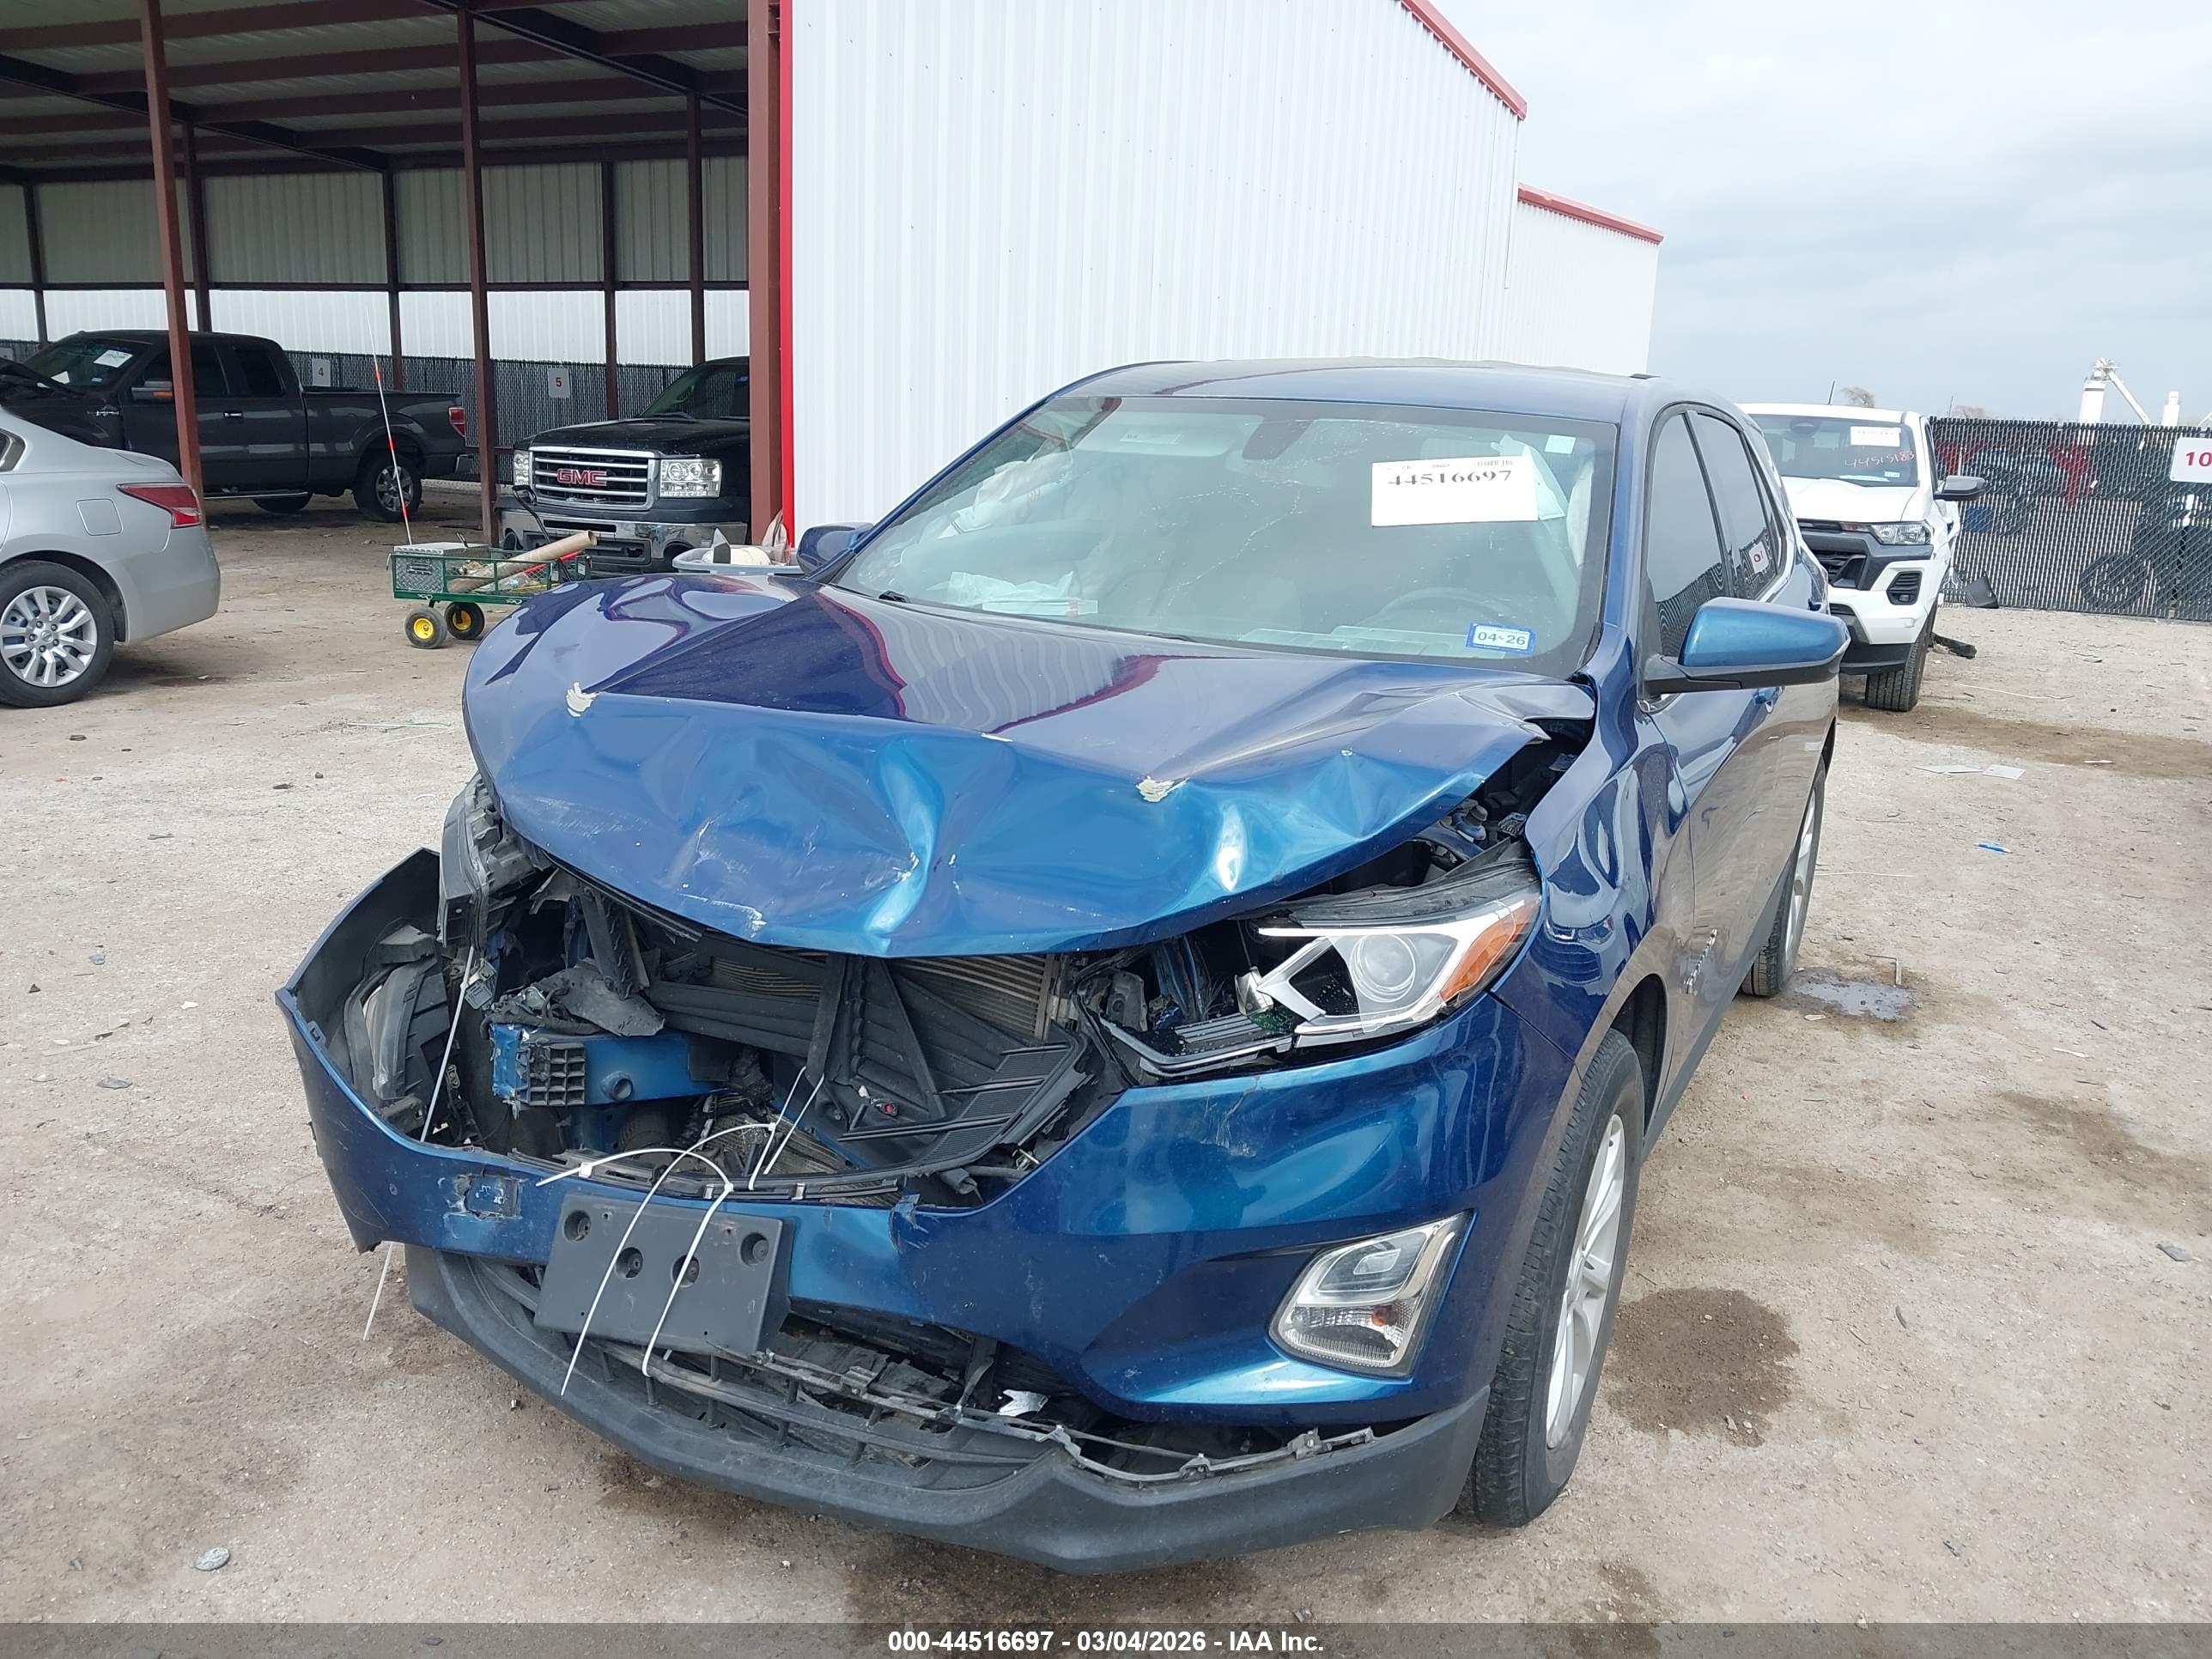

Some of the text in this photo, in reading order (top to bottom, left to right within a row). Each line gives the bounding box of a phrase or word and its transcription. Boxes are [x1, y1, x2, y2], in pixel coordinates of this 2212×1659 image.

[318, 367, 325, 377] 4
[556, 377, 562, 387] 5
[557, 468, 607, 487] GMC
[1388, 470, 1512, 486] 44516697
